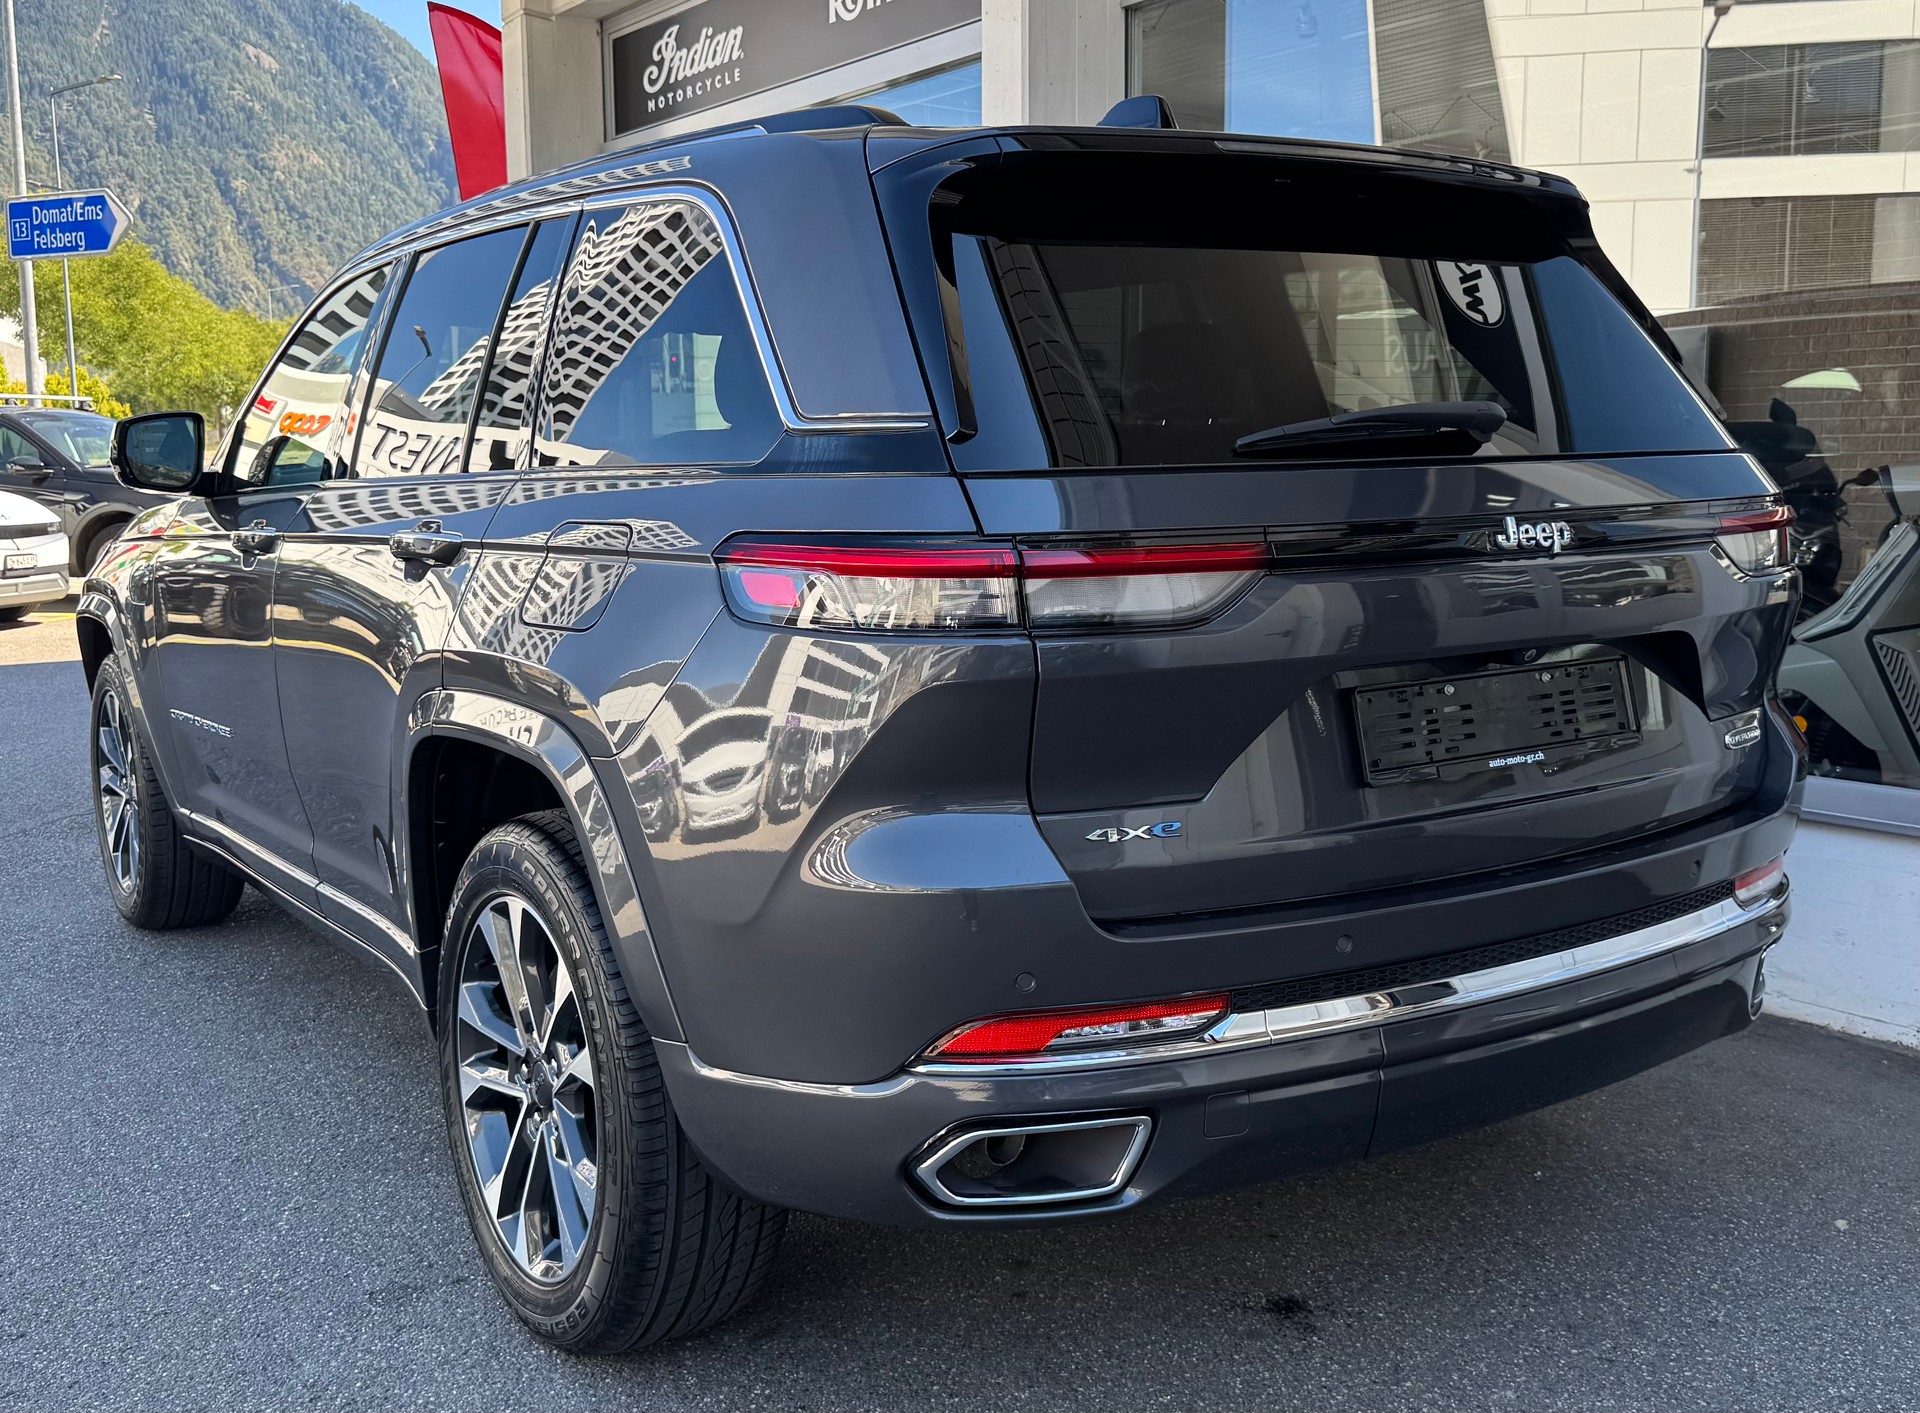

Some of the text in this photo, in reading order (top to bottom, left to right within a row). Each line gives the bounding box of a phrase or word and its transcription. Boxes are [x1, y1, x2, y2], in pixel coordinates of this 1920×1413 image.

[643, 24, 744, 94] Indian
[647, 68, 741, 113] MOTORCYCLE
[32, 202, 103, 225] Domat/Ems
[15, 222, 27, 238] 13
[33, 228, 86, 251] Felsberg
[1496, 515, 1571, 554] Jeep
[1488, 750, 1545, 768] auto-moto-gr.ch
